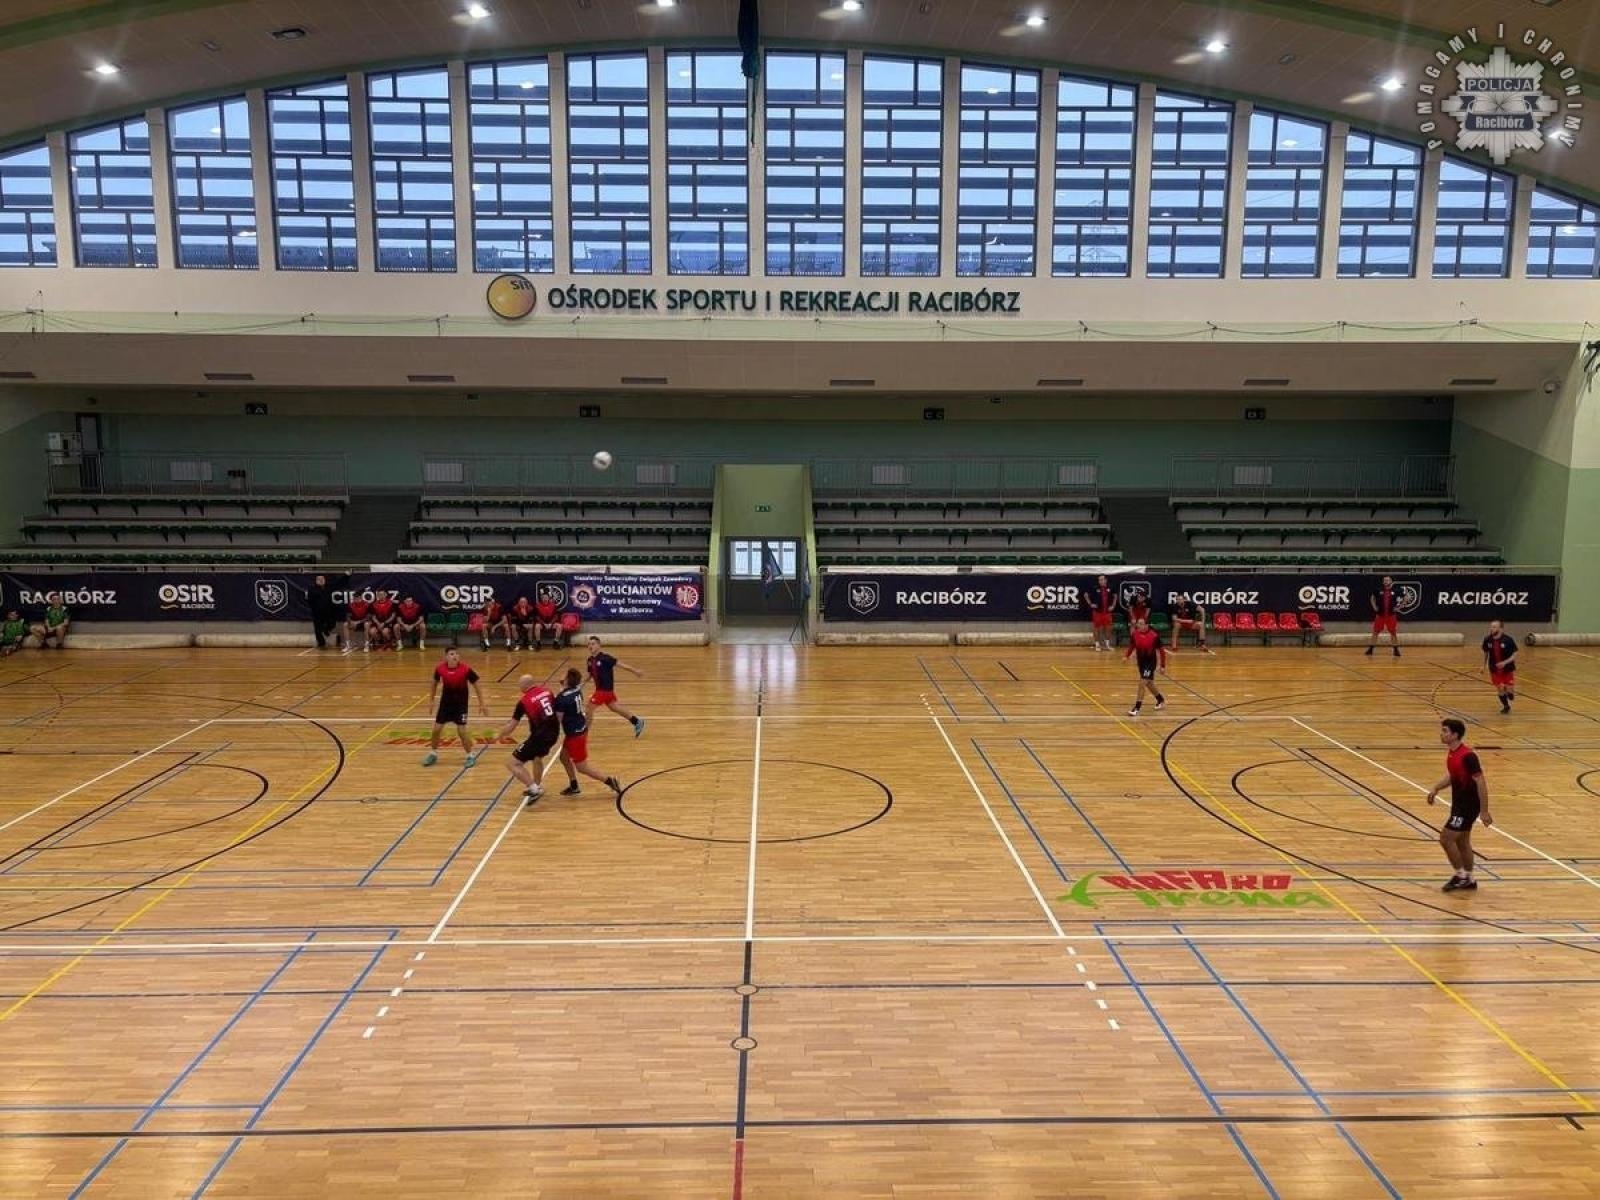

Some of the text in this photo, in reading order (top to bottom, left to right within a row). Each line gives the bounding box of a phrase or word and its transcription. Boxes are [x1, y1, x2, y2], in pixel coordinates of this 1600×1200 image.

[548, 285, 1021, 312] OŚRODEK SPORTU I REKREACJI RACIBÓRZ
[158, 584, 215, 604] OSiR
[597, 583, 673, 596] POLICJANTÓW
[895, 587, 987, 606] RACIBÓRZ
[1026, 585, 1080, 604] OSiR
[1298, 585, 1351, 605] OSiR
[1437, 587, 1529, 606] RACIBÓRZ
[539, 697, 553, 717] 5
